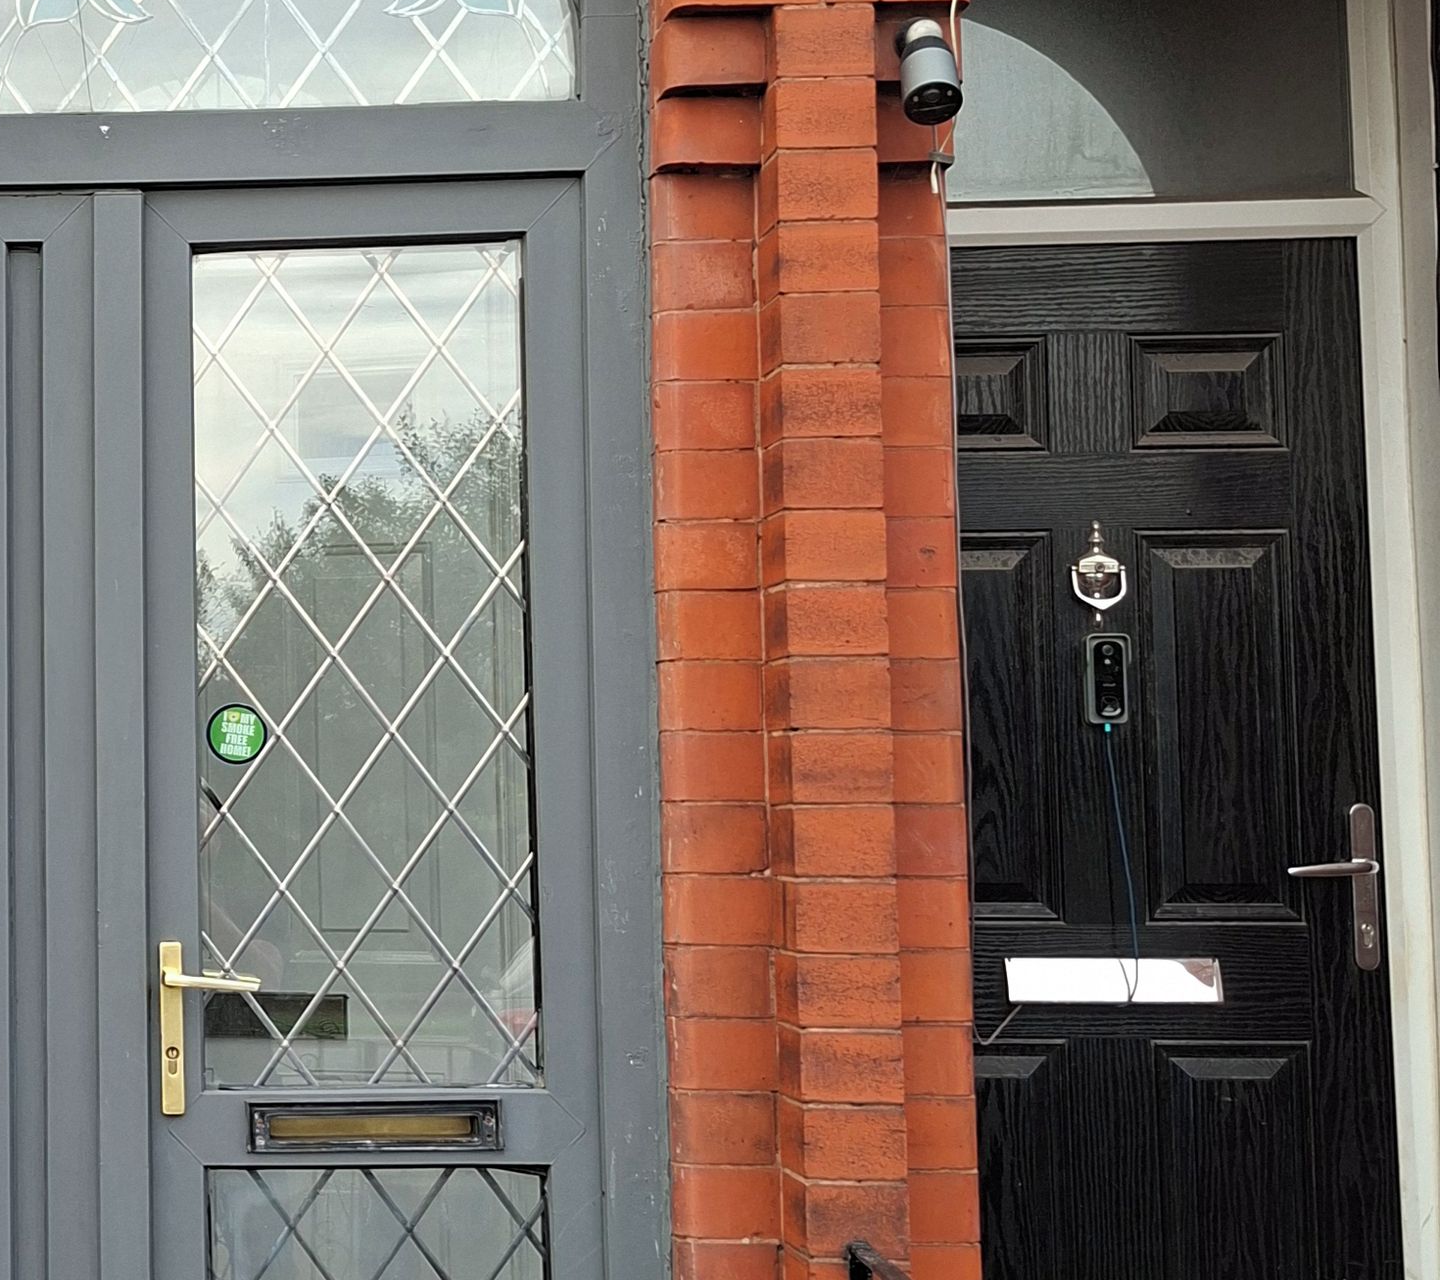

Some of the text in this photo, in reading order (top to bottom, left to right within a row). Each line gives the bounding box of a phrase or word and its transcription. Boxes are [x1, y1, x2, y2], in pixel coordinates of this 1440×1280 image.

[223, 710, 256, 725] I MY
[221, 721, 255, 736] SMOKE
[225, 733, 249, 746] FREE
[220, 743, 251, 757] HOME!
